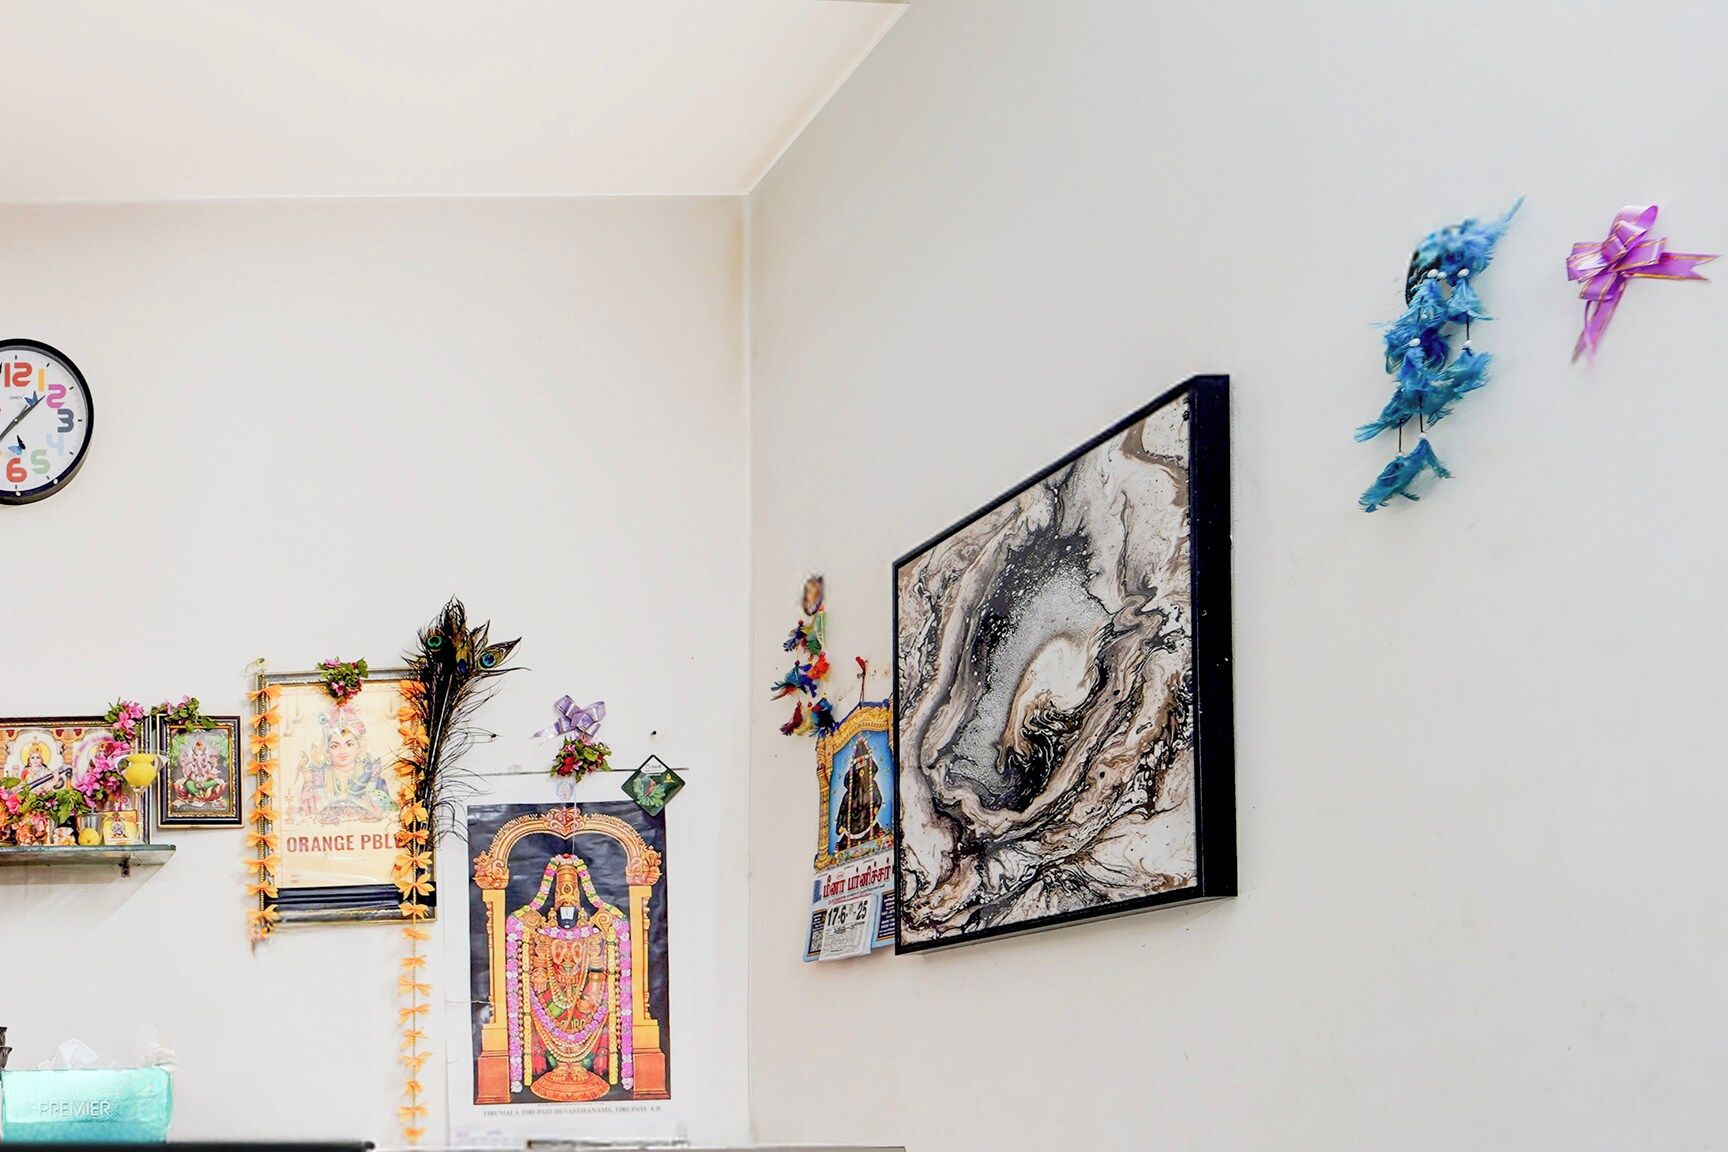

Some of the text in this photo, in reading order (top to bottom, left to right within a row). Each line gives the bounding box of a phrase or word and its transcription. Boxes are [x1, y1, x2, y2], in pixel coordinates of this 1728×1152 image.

[4, 362, 33, 388] 12
[46, 384, 67, 409] 2
[57, 408, 75, 433] 3
[46, 432, 64, 456] 4
[6, 457, 28, 483] 6
[30, 449, 51, 475] 5
[286, 834, 354, 853] ORANGE
[39, 1100, 112, 1118] PREMIER
